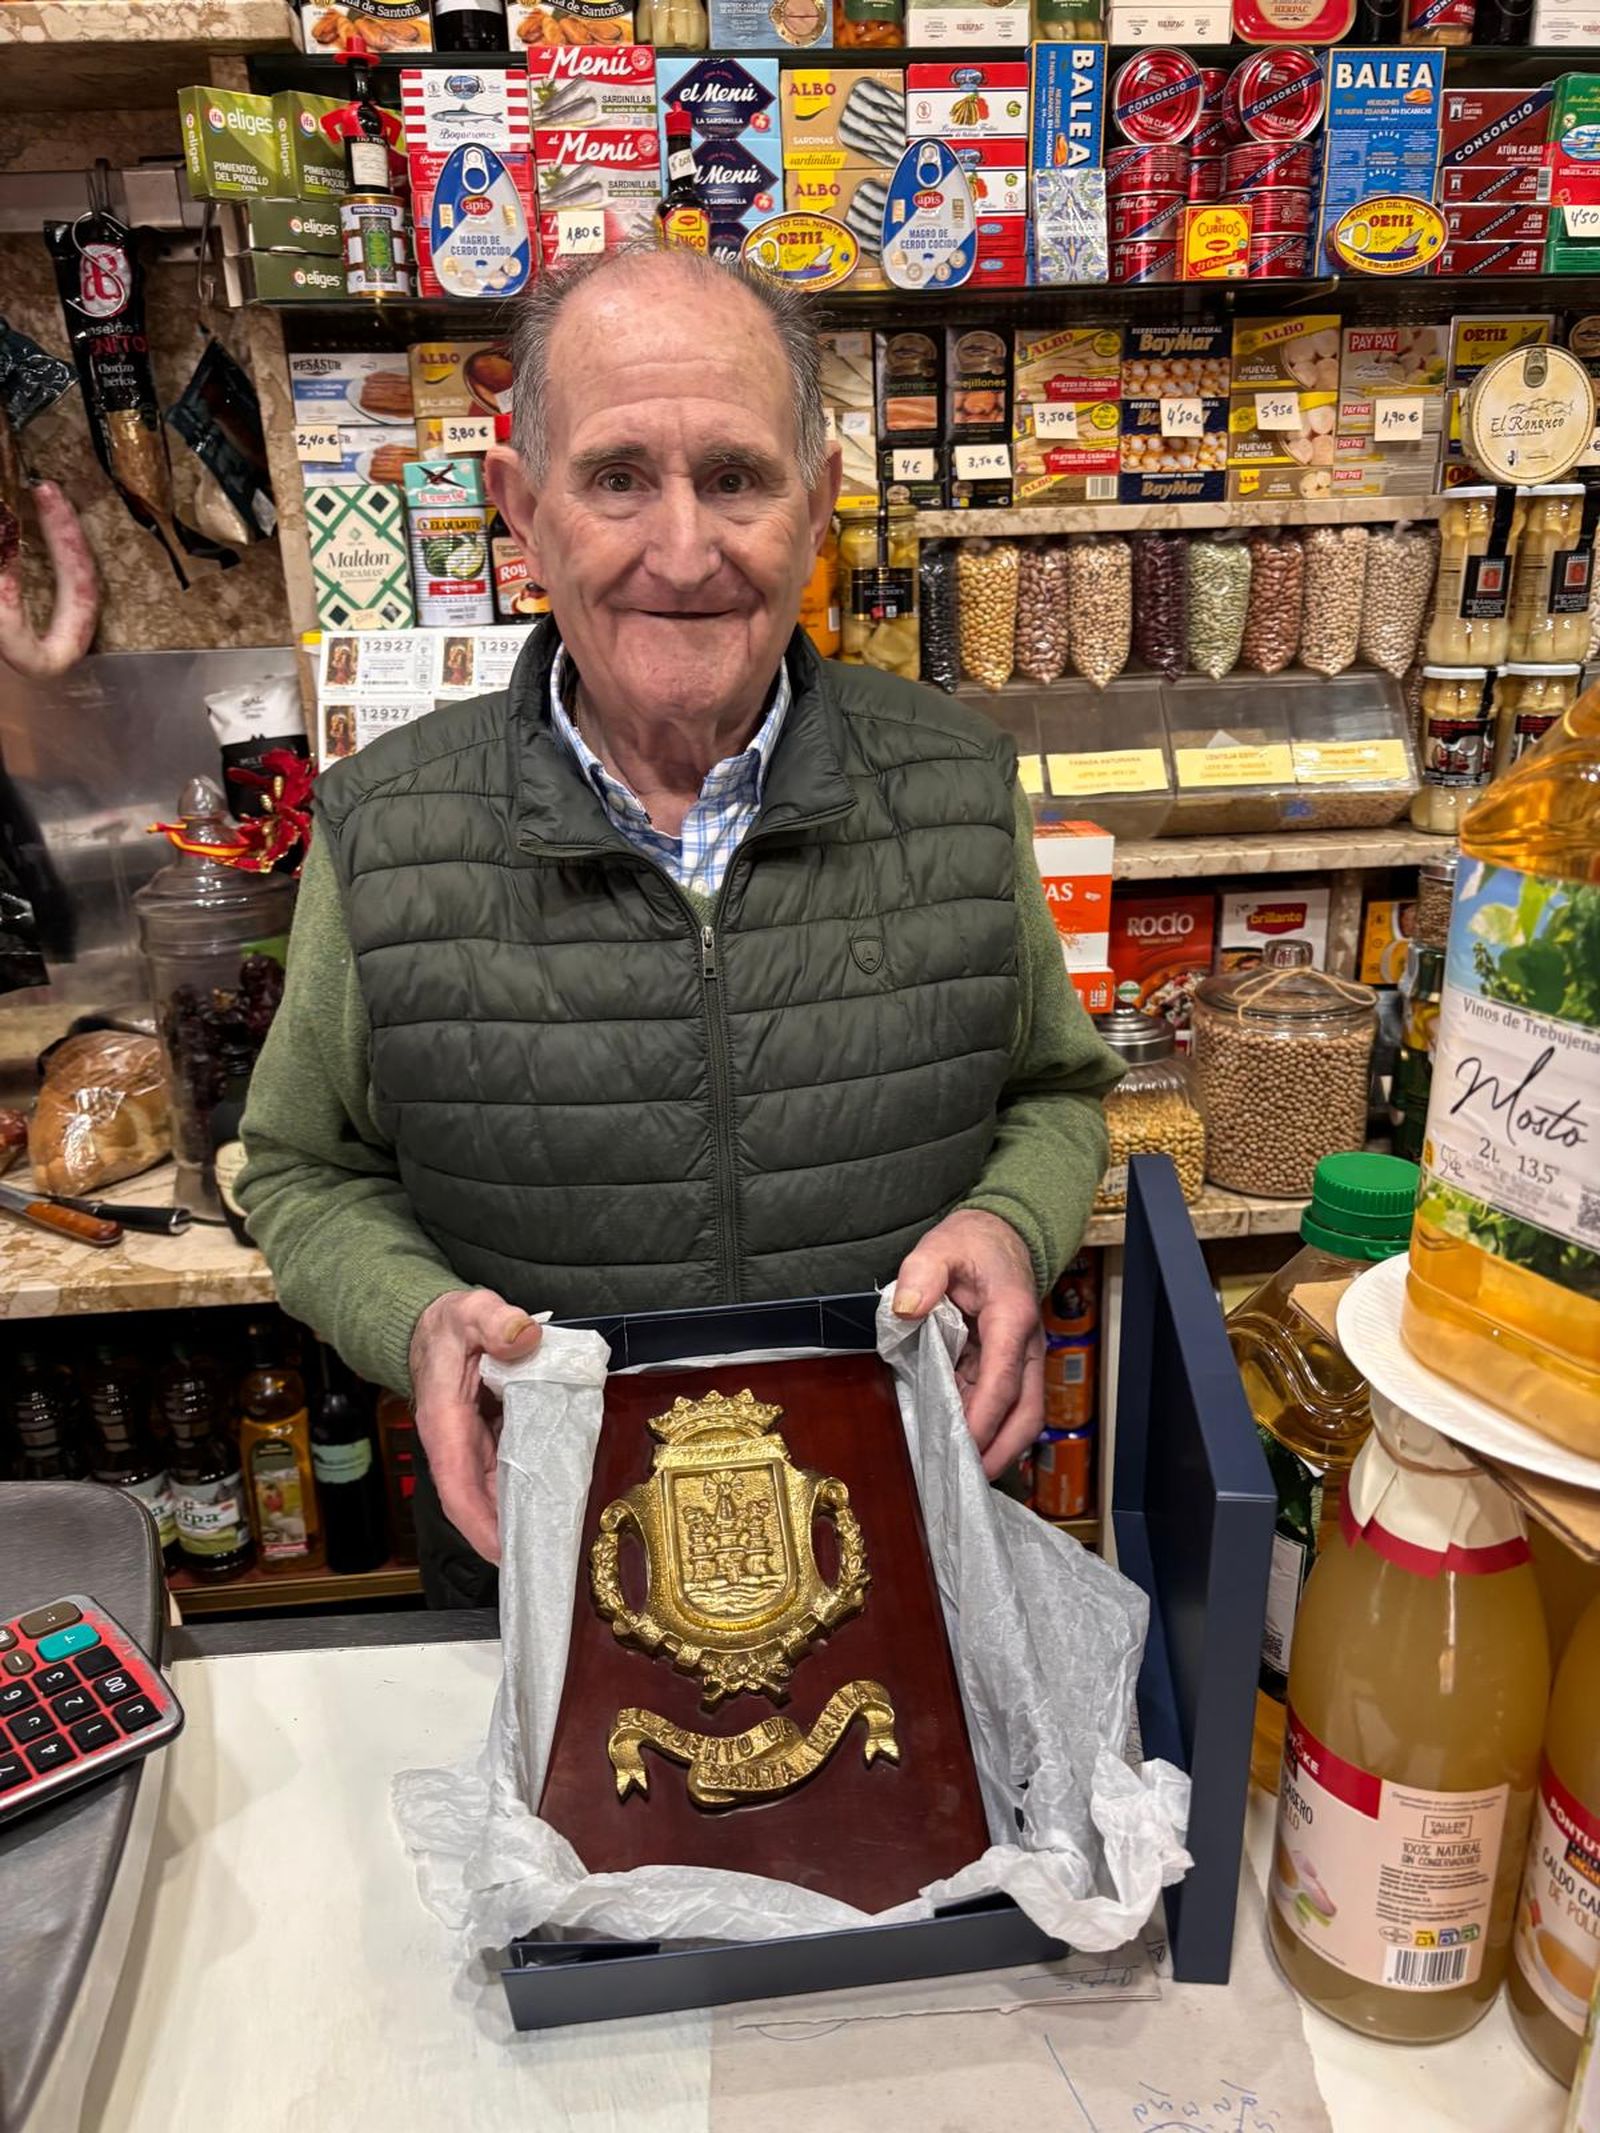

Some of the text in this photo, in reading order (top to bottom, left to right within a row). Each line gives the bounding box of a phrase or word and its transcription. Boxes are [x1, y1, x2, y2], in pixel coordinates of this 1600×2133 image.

[361, 1, 422, 17] de Santoña
[567, 1, 624, 17] de Santoña
[548, 47, 632, 78] Menú
[1335, 63, 1434, 89] BALEA
[680, 83, 757, 103] el Menú
[788, 84, 837, 96] ALBO
[1252, 78, 1309, 115] CONSORCIO
[601, 95, 651, 105] SARDINILLAS
[1128, 82, 1187, 113] CONSORCIO
[1068, 49, 1097, 167] BALEA
[227, 108, 274, 136] eliges
[705, 117, 743, 125] SARDINILLA
[1455, 103, 1533, 161] CONSORCIO
[793, 136, 834, 145] SARDINAS
[556, 132, 638, 165] Menú
[1497, 143, 1543, 155] ATÚN CLARO
[789, 153, 841, 166] sardinillas
[1256, 148, 1298, 178] CONSORCIO
[213, 161, 258, 175] PIMIENTOS
[304, 165, 346, 178] PIMIENTOS
[702, 164, 760, 184] Menú
[214, 171, 269, 187] DEL PIQUILLO
[305, 175, 320, 186] DEL
[608, 180, 657, 190] SARDINILLAS
[1477, 170, 1518, 201] CONSORCIO
[1519, 182, 1537, 190] CLARO
[793, 184, 841, 196] ALBO
[465, 201, 490, 214] apis
[917, 196, 941, 207] apis
[1349, 202, 1384, 221] BONITO
[1528, 212, 1543, 221] ATÚN
[303, 219, 337, 237] eliges
[1369, 215, 1414, 227] ORTIZ
[1475, 209, 1516, 240] CONSORCIO
[1523, 221, 1542, 229] CLARO
[567, 226, 601, 246] 1,80 €
[909, 229, 948, 239] MAGRO DE
[1197, 221, 1241, 237] CUBITOS
[460, 235, 501, 245] MAGRO DE
[777, 231, 824, 245] ORTIZ
[900, 239, 958, 250] CERDO COCIDO
[451, 246, 511, 256] CERDO COCIDO
[1522, 250, 1537, 258] ATÚN
[1352, 255, 1424, 268] EN ESCABECHE
[1468, 246, 1510, 275] CONSORCIO
[1517, 258, 1537, 266] CLARO
[307, 271, 341, 288] eliges
[1191, 326, 1222, 334] NATURAL
[1261, 322, 1305, 342] ALBO
[1463, 328, 1509, 342] ORTIZ
[1032, 332, 1073, 357] ALBO
[1139, 333, 1213, 355] BayMar
[1351, 333, 1398, 350] PAY PAY
[293, 358, 342, 371] PESASUR
[418, 353, 461, 363] ALBO
[1240, 365, 1277, 375] HUEVAS
[1343, 405, 1370, 415] PAY PAY
[1409, 413, 1419, 423] €
[298, 434, 326, 449] 2,40
[327, 434, 338, 445] €
[448, 427, 488, 442] 3,80 €
[1237, 442, 1273, 452] HUEVAS
[1338, 438, 1364, 448] PAY PAY
[901, 460, 922, 473] 4 €
[995, 456, 1006, 466] €
[1335, 471, 1362, 480] PAY PAY
[1023, 476, 1052, 494] ALBO
[1141, 481, 1204, 499] BayMar
[430, 520, 480, 531] EL QUIJOTE
[326, 549, 392, 569] Maldon
[500, 563, 528, 580] Roy
[364, 640, 414, 653] 12927
[480, 641, 520, 652] 1292
[360, 708, 411, 721] 12927
[1250, 908, 1303, 925] brillante
[1464, 996, 1600, 1054] Vinos de Trebujena
[1450, 1045, 1589, 1147] Mosto
[1478, 1136, 1501, 1164] 2L
[105, 1676, 127, 1693] 00
[656, 1727, 755, 1760] PUERTO
[761, 1720, 793, 1742] DE
[708, 1763, 800, 1790] SANTA
[1430, 1820, 1466, 1828] TALLER
[1402, 1842, 1482, 1857] 100% NATURAL
[1543, 1847, 1575, 1895] CALDO
[1549, 1880, 1564, 1906] DE
